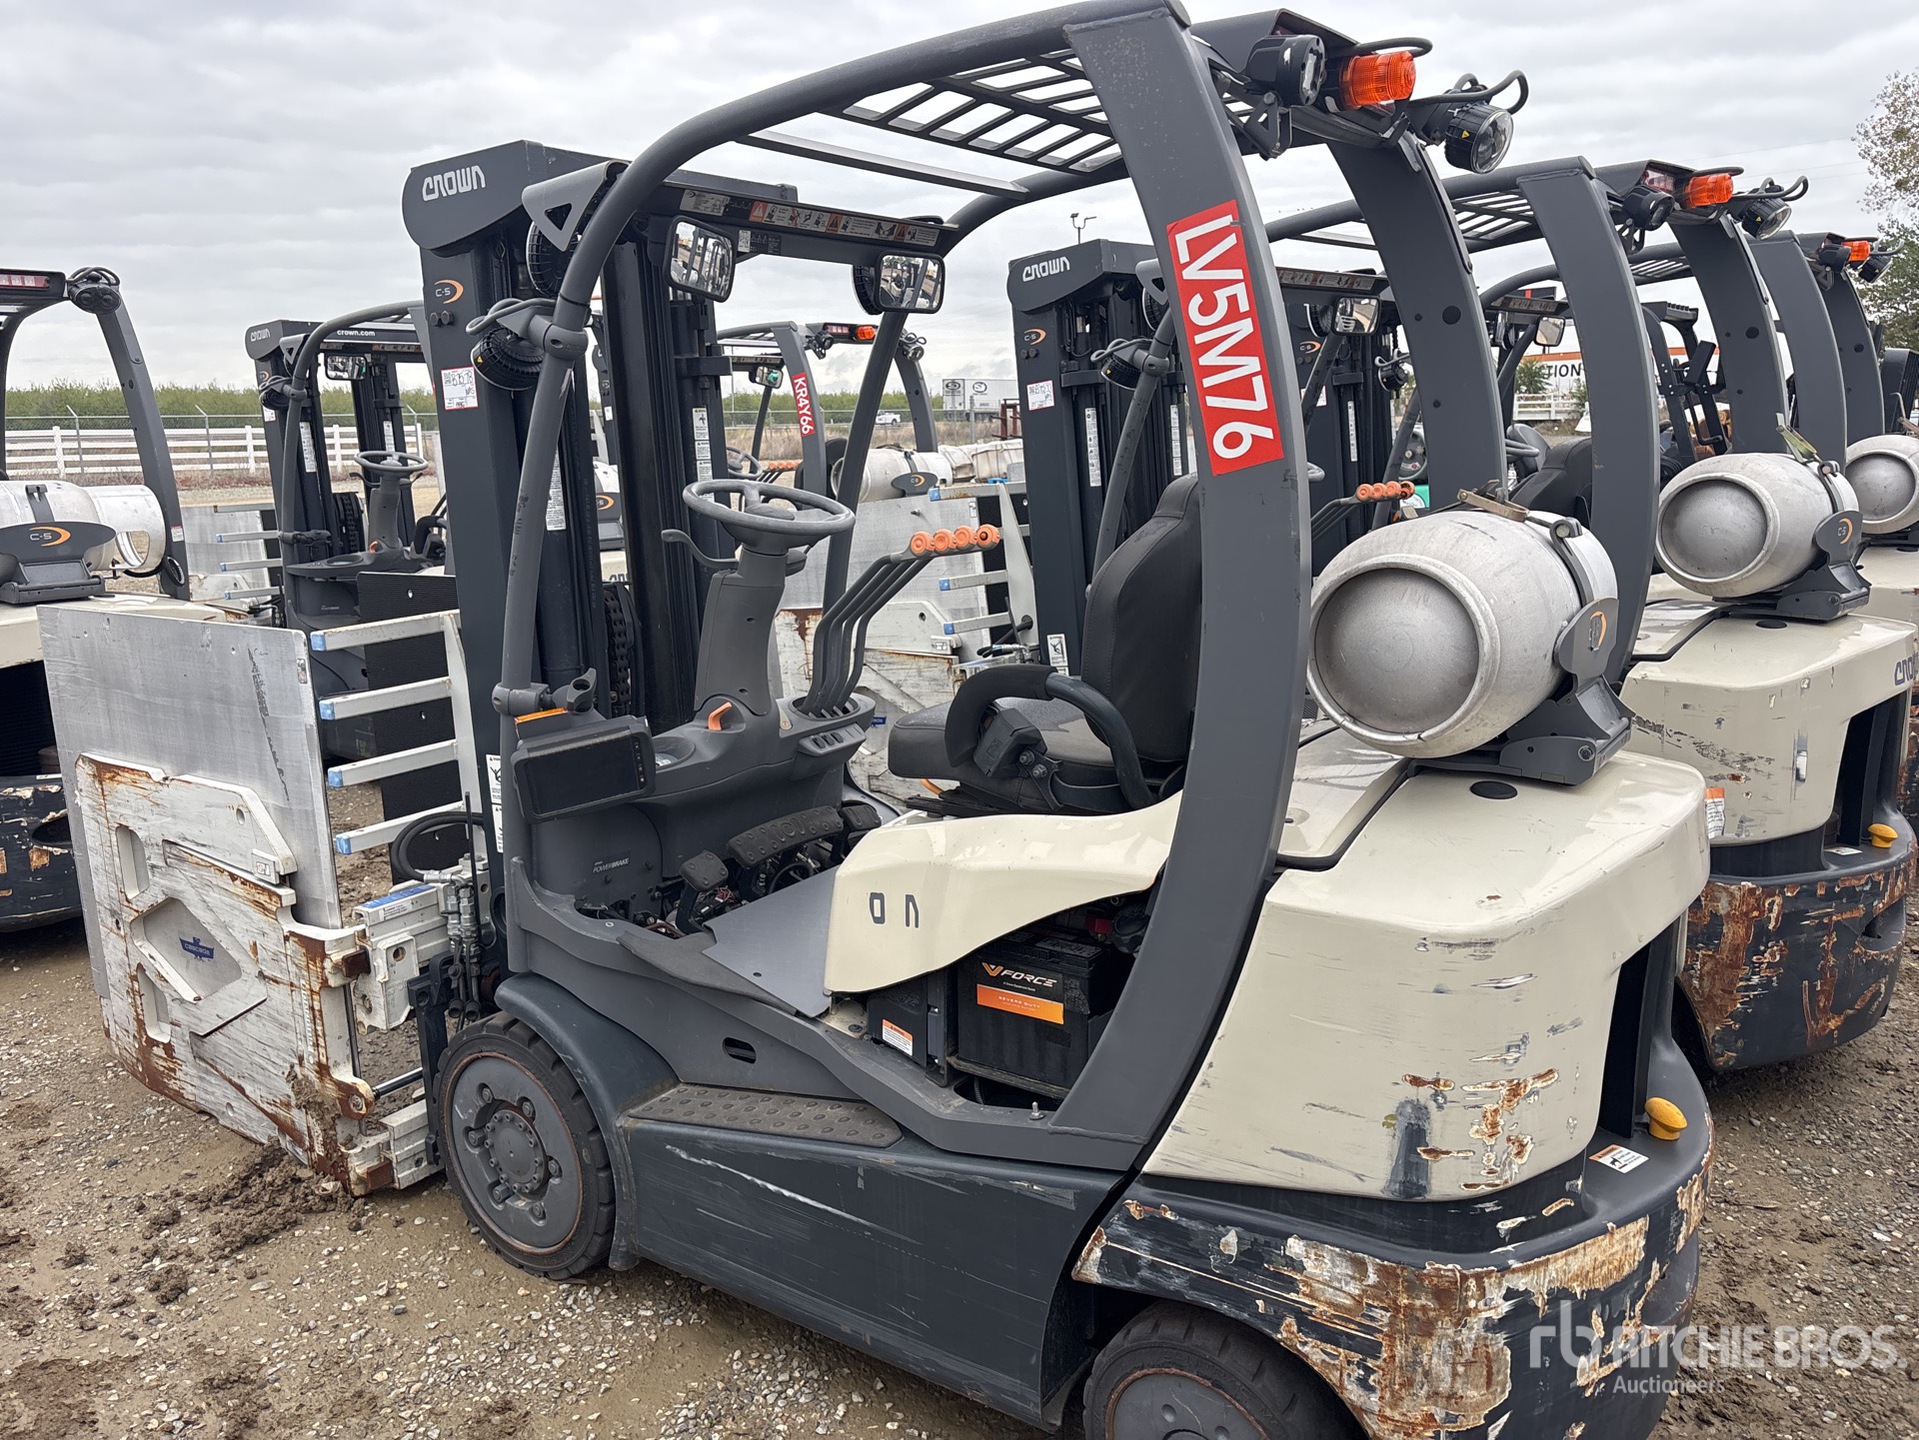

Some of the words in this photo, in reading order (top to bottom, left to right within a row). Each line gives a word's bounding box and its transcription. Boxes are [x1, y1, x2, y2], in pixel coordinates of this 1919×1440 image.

[422, 165, 486, 201] CROWN
[1022, 256, 1070, 282] CROWN
[336, 329, 376, 337] crown.com
[1175, 214, 1274, 459] LV5M76
[794, 377, 814, 434] KR4Y66
